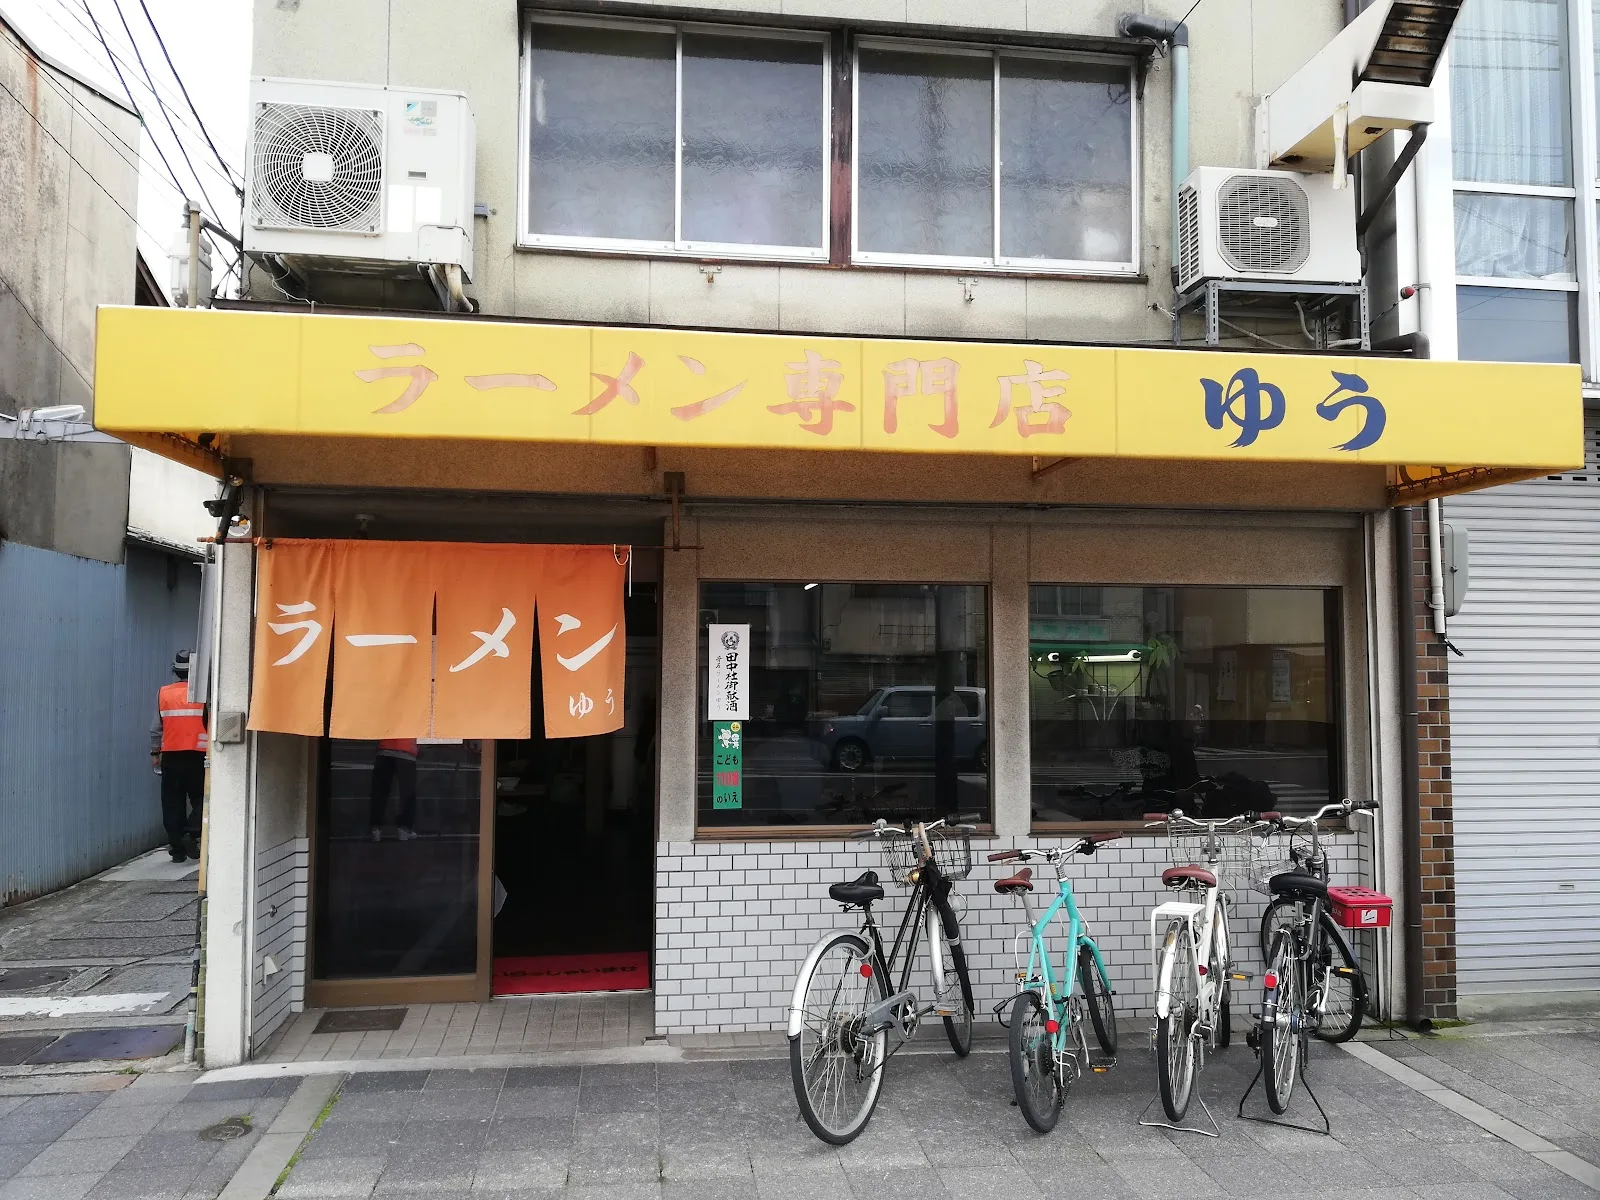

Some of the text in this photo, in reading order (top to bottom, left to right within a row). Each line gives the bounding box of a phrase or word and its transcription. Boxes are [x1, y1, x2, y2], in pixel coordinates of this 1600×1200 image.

[354, 345, 1388, 451] ラーメン専門店 ゆう
[267, 600, 619, 674] ラーメン
[568, 688, 615, 720] ゆう
[716, 754, 739, 766] こども
[716, 771, 740, 787] 110番
[716, 791, 739, 804] のいえ
